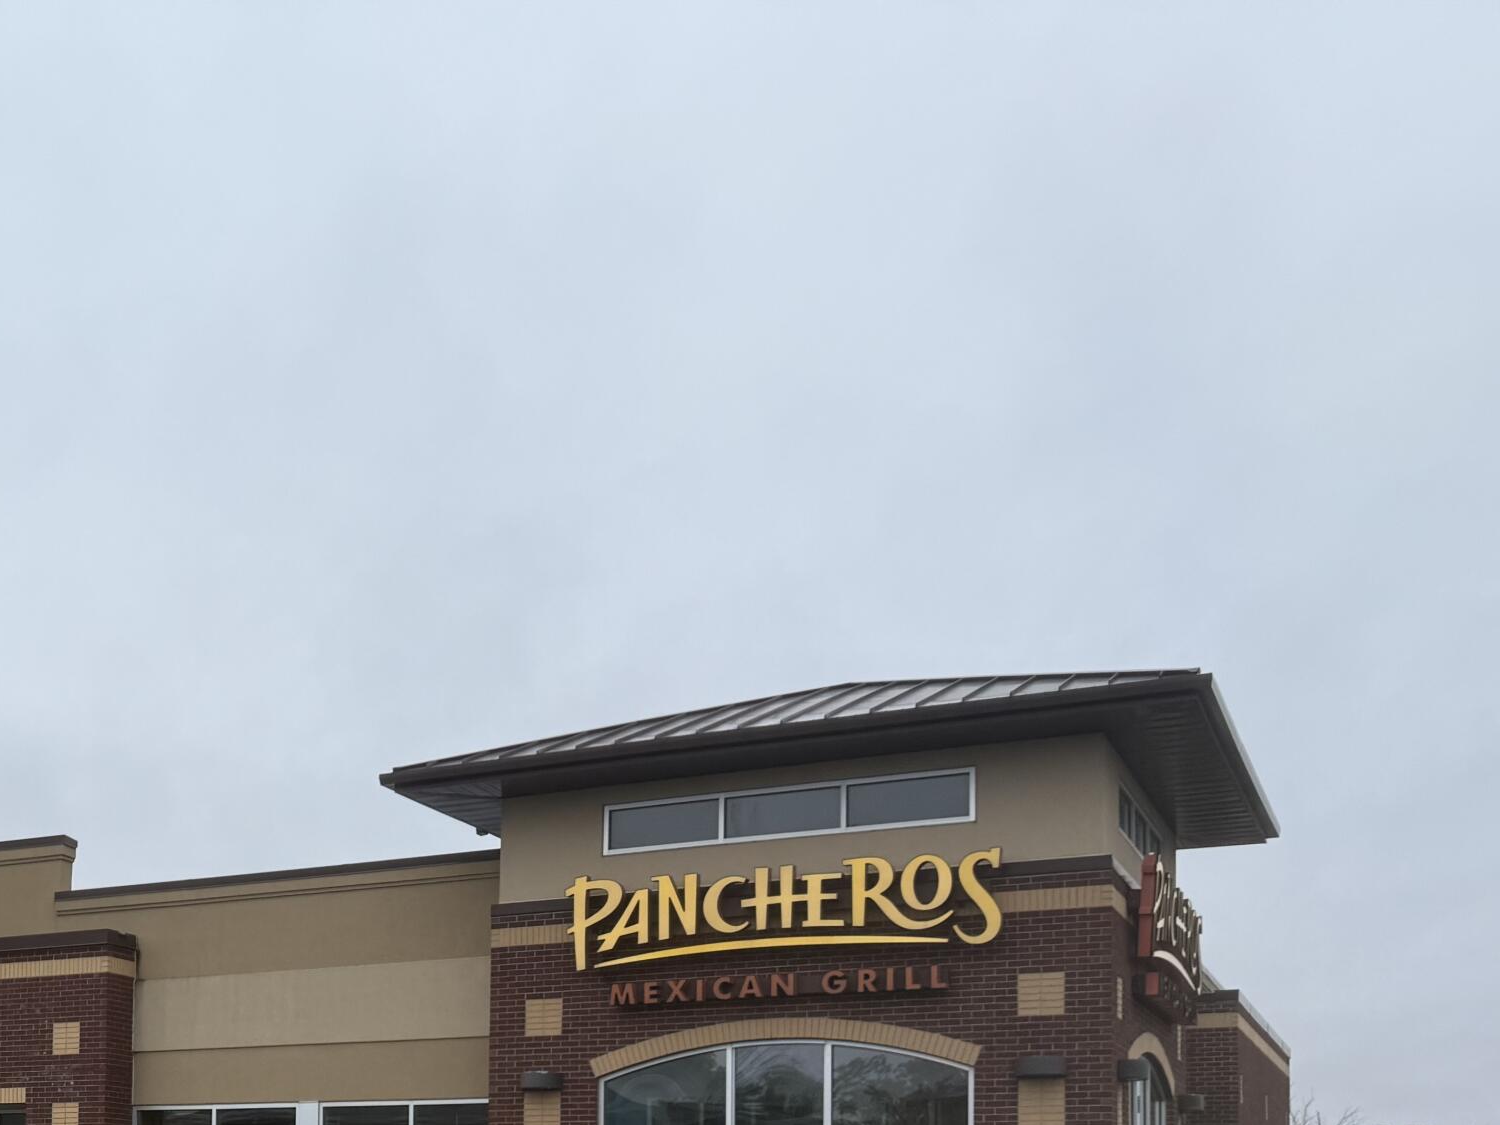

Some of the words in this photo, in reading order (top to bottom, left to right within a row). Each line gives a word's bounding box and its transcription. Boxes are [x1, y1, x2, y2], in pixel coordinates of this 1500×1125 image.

[564, 847, 1003, 971] PANCHEROS
[610, 973, 797, 1006] MEXICAN
[821, 965, 950, 996] GRILL
